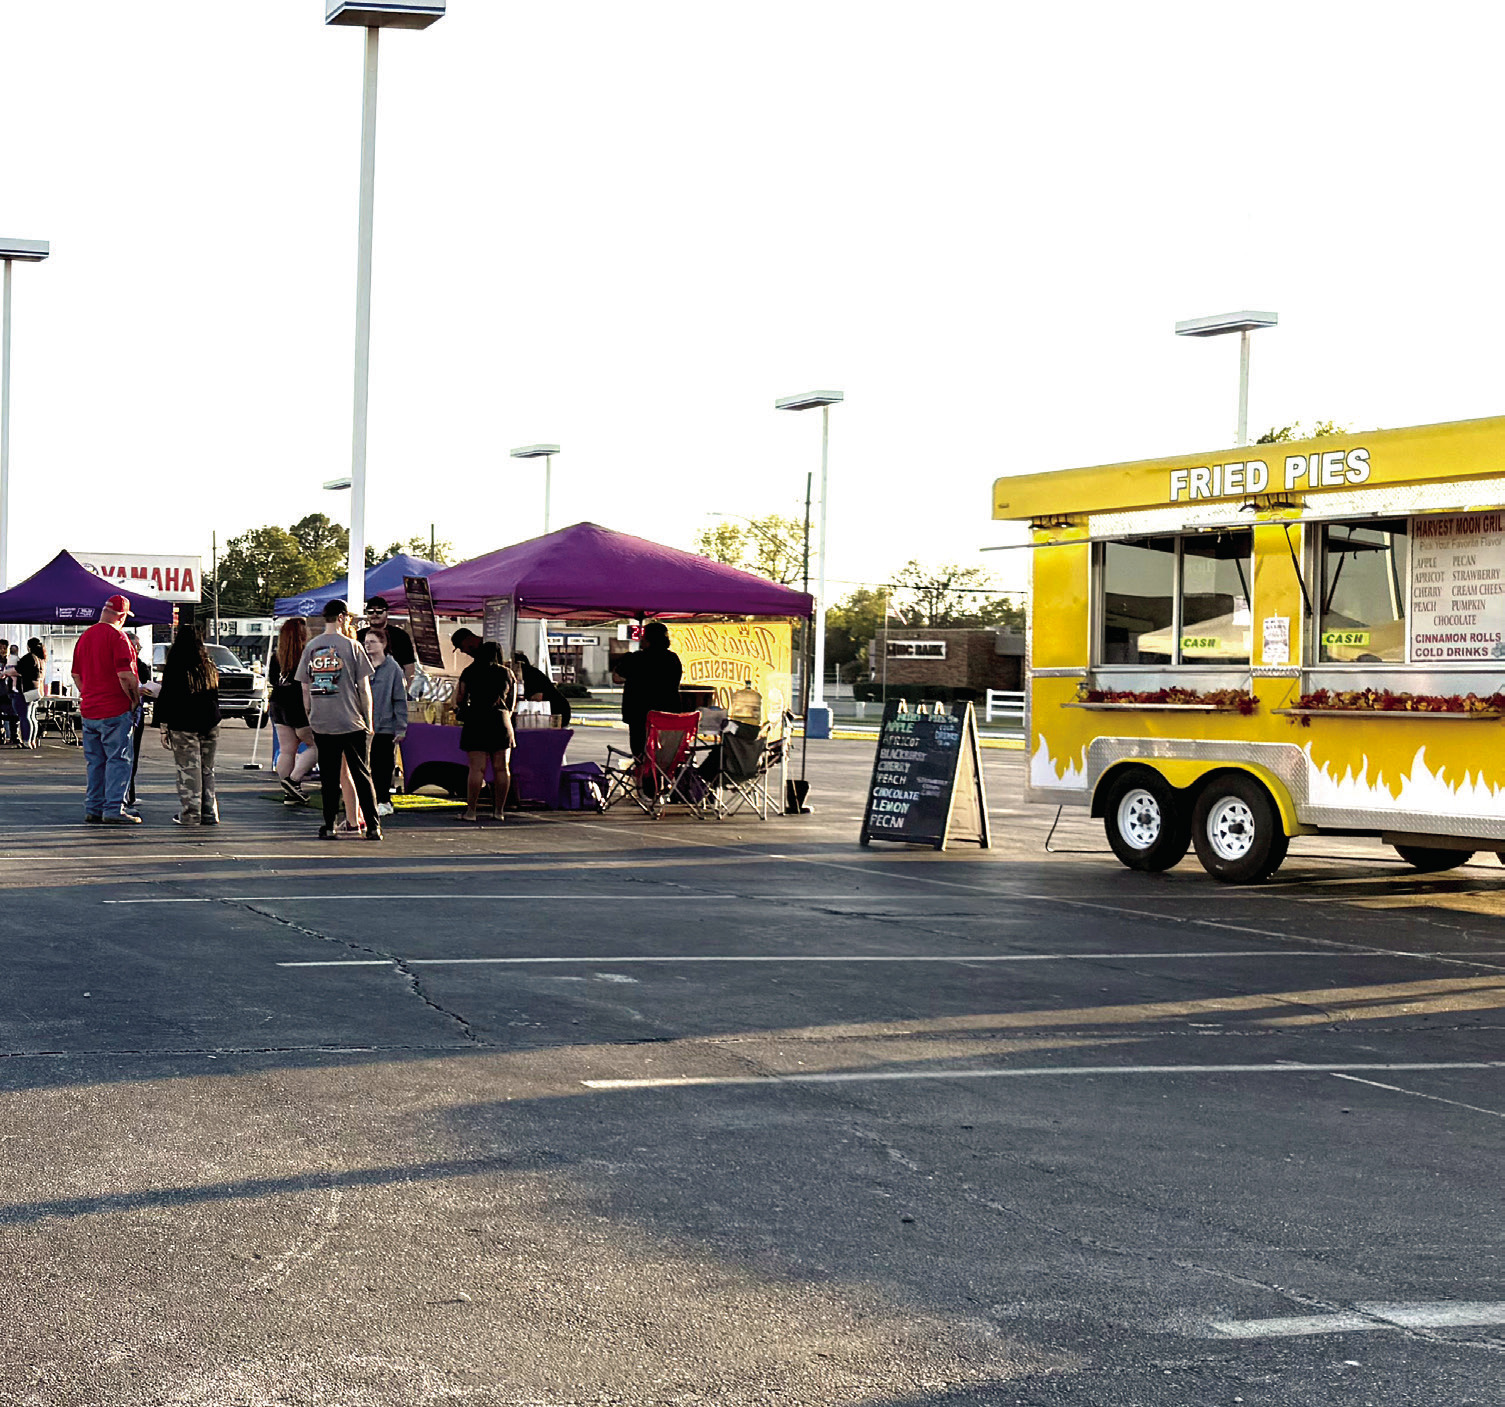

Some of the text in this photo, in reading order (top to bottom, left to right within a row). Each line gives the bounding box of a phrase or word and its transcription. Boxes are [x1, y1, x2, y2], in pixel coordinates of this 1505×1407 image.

[1169, 447, 1371, 502] FRIED PIES
[1415, 518, 1454, 537] HARVEST
[1456, 517, 1480, 534] MOON
[1481, 536, 1502, 547] Flavor
[1416, 557, 1437, 569] APPLE
[1452, 554, 1476, 567] PECAN
[1415, 571, 1445, 583] APRICOT
[1452, 569, 1501, 581] STRAWBERRY
[1414, 586, 1442, 598] CHERRY
[1452, 585, 1477, 597] CREAM
[1414, 601, 1437, 612] PEACH
[1451, 599, 1486, 611] PUMPKIN
[1433, 614, 1477, 626] CHOCOLATE
[1183, 638, 1216, 648] CASH
[1326, 633, 1364, 644] CASH
[1415, 632, 1502, 644] CINNAMON ROLLS
[1415, 646, 1489, 657] COLD DRINKS
[876, 773, 907, 785] PEACH
[873, 787, 920, 801] CHOCOLATE
[872, 799, 911, 814] LEMON
[870, 814, 905, 828] PECAN
